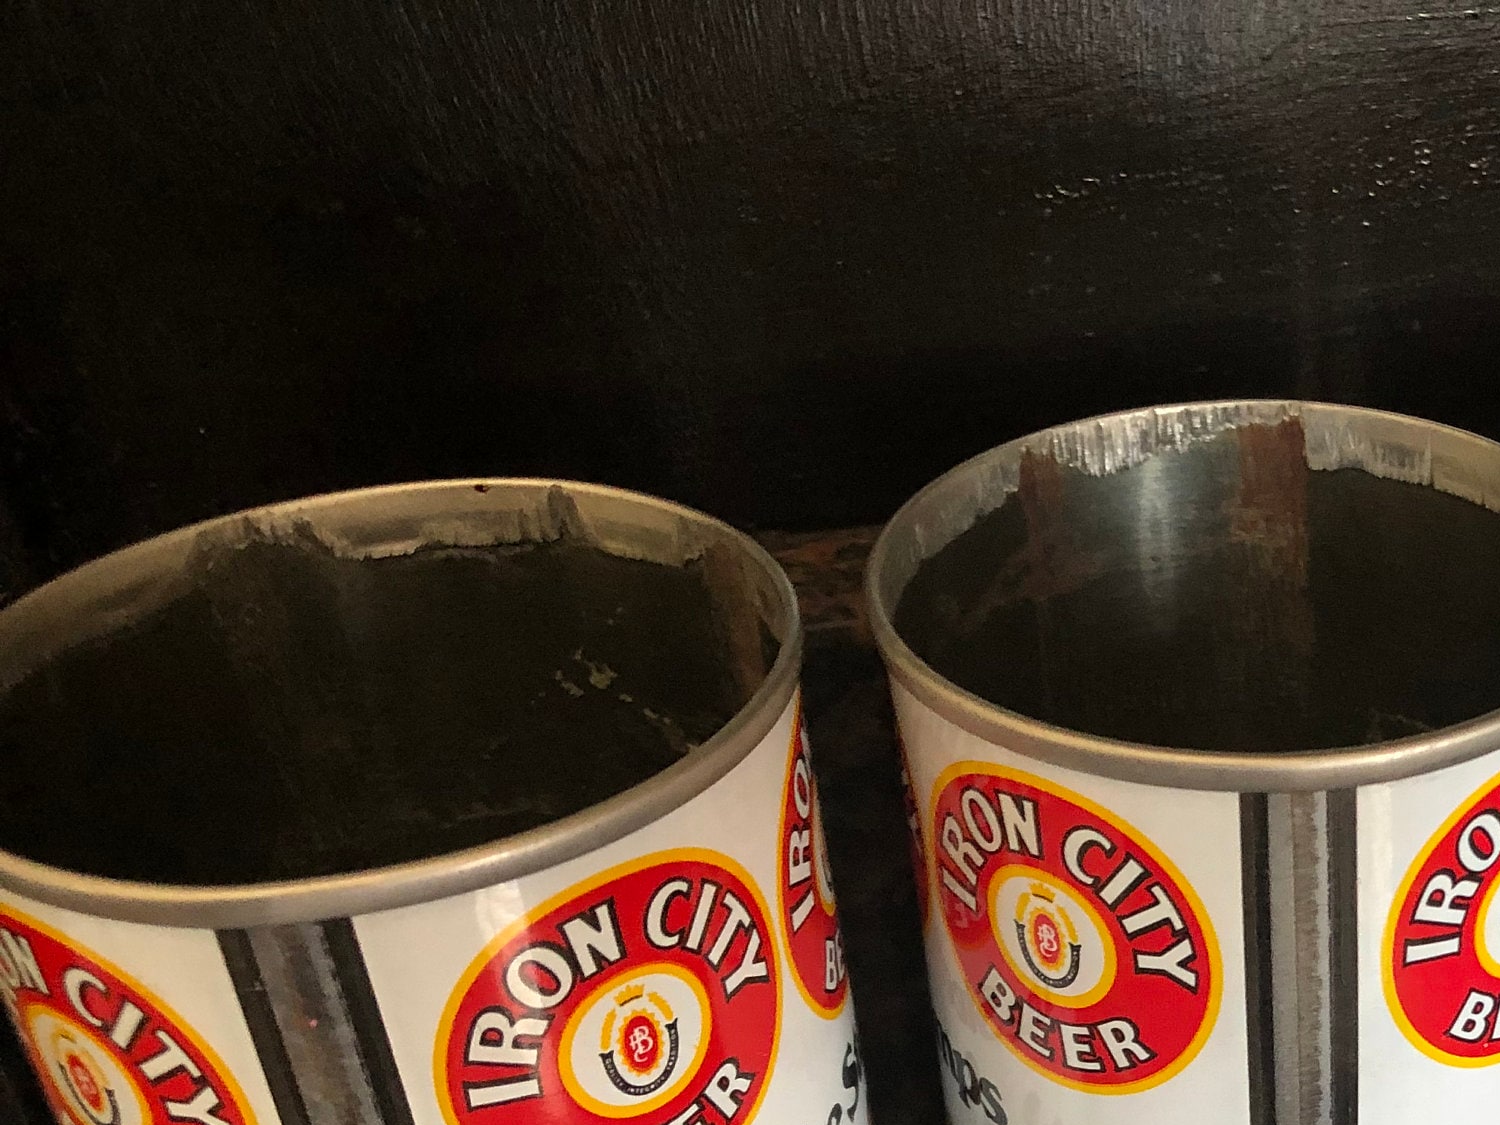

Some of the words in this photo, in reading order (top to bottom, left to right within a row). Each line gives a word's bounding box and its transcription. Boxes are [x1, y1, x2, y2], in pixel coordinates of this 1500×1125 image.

[463, 898, 627, 1112] IRON
[644, 876, 770, 1003] CITY
[938, 786, 1044, 914] IRON
[1062, 824, 1199, 994] CITY
[978, 961, 1158, 1075] BEER
